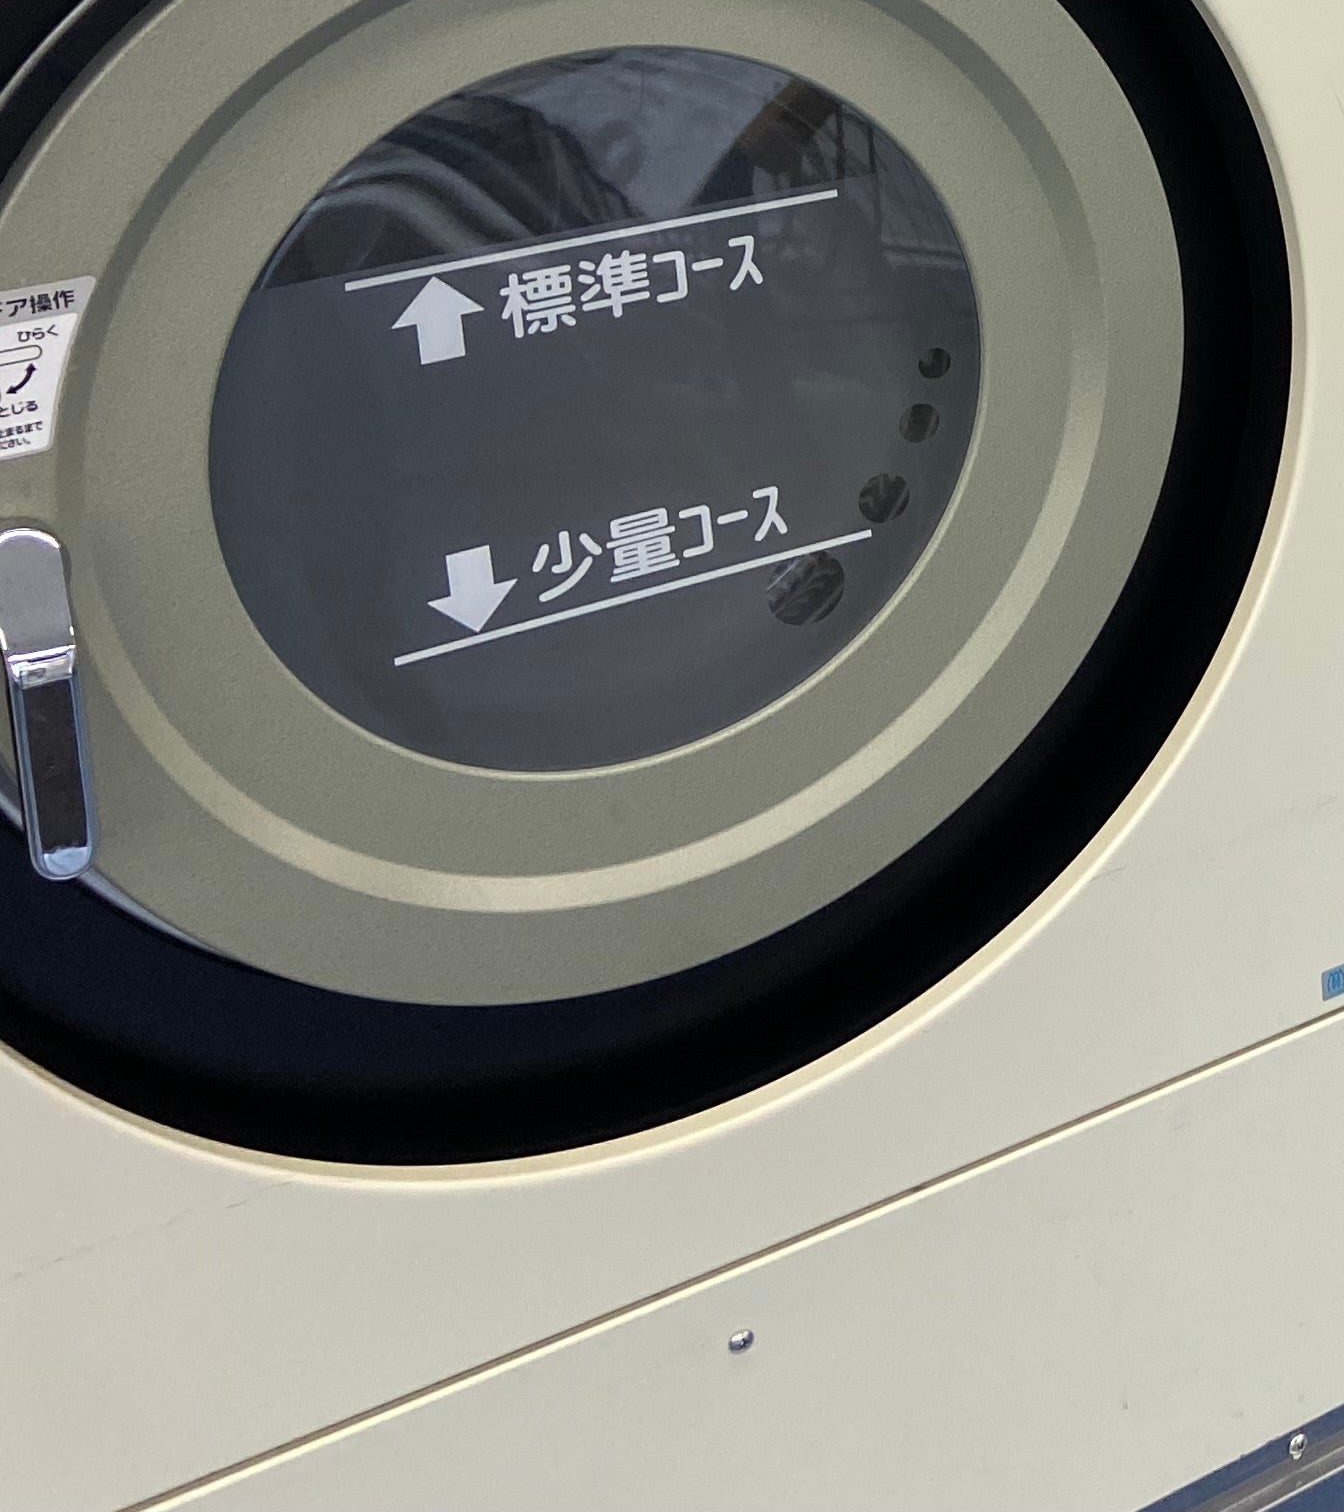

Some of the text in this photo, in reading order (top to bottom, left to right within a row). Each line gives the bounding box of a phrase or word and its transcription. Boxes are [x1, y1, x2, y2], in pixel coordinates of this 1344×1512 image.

[17, 324, 59, 343] ひらく
[498, 233, 765, 340] 標準コース
[531, 485, 789, 603] 少量コース
